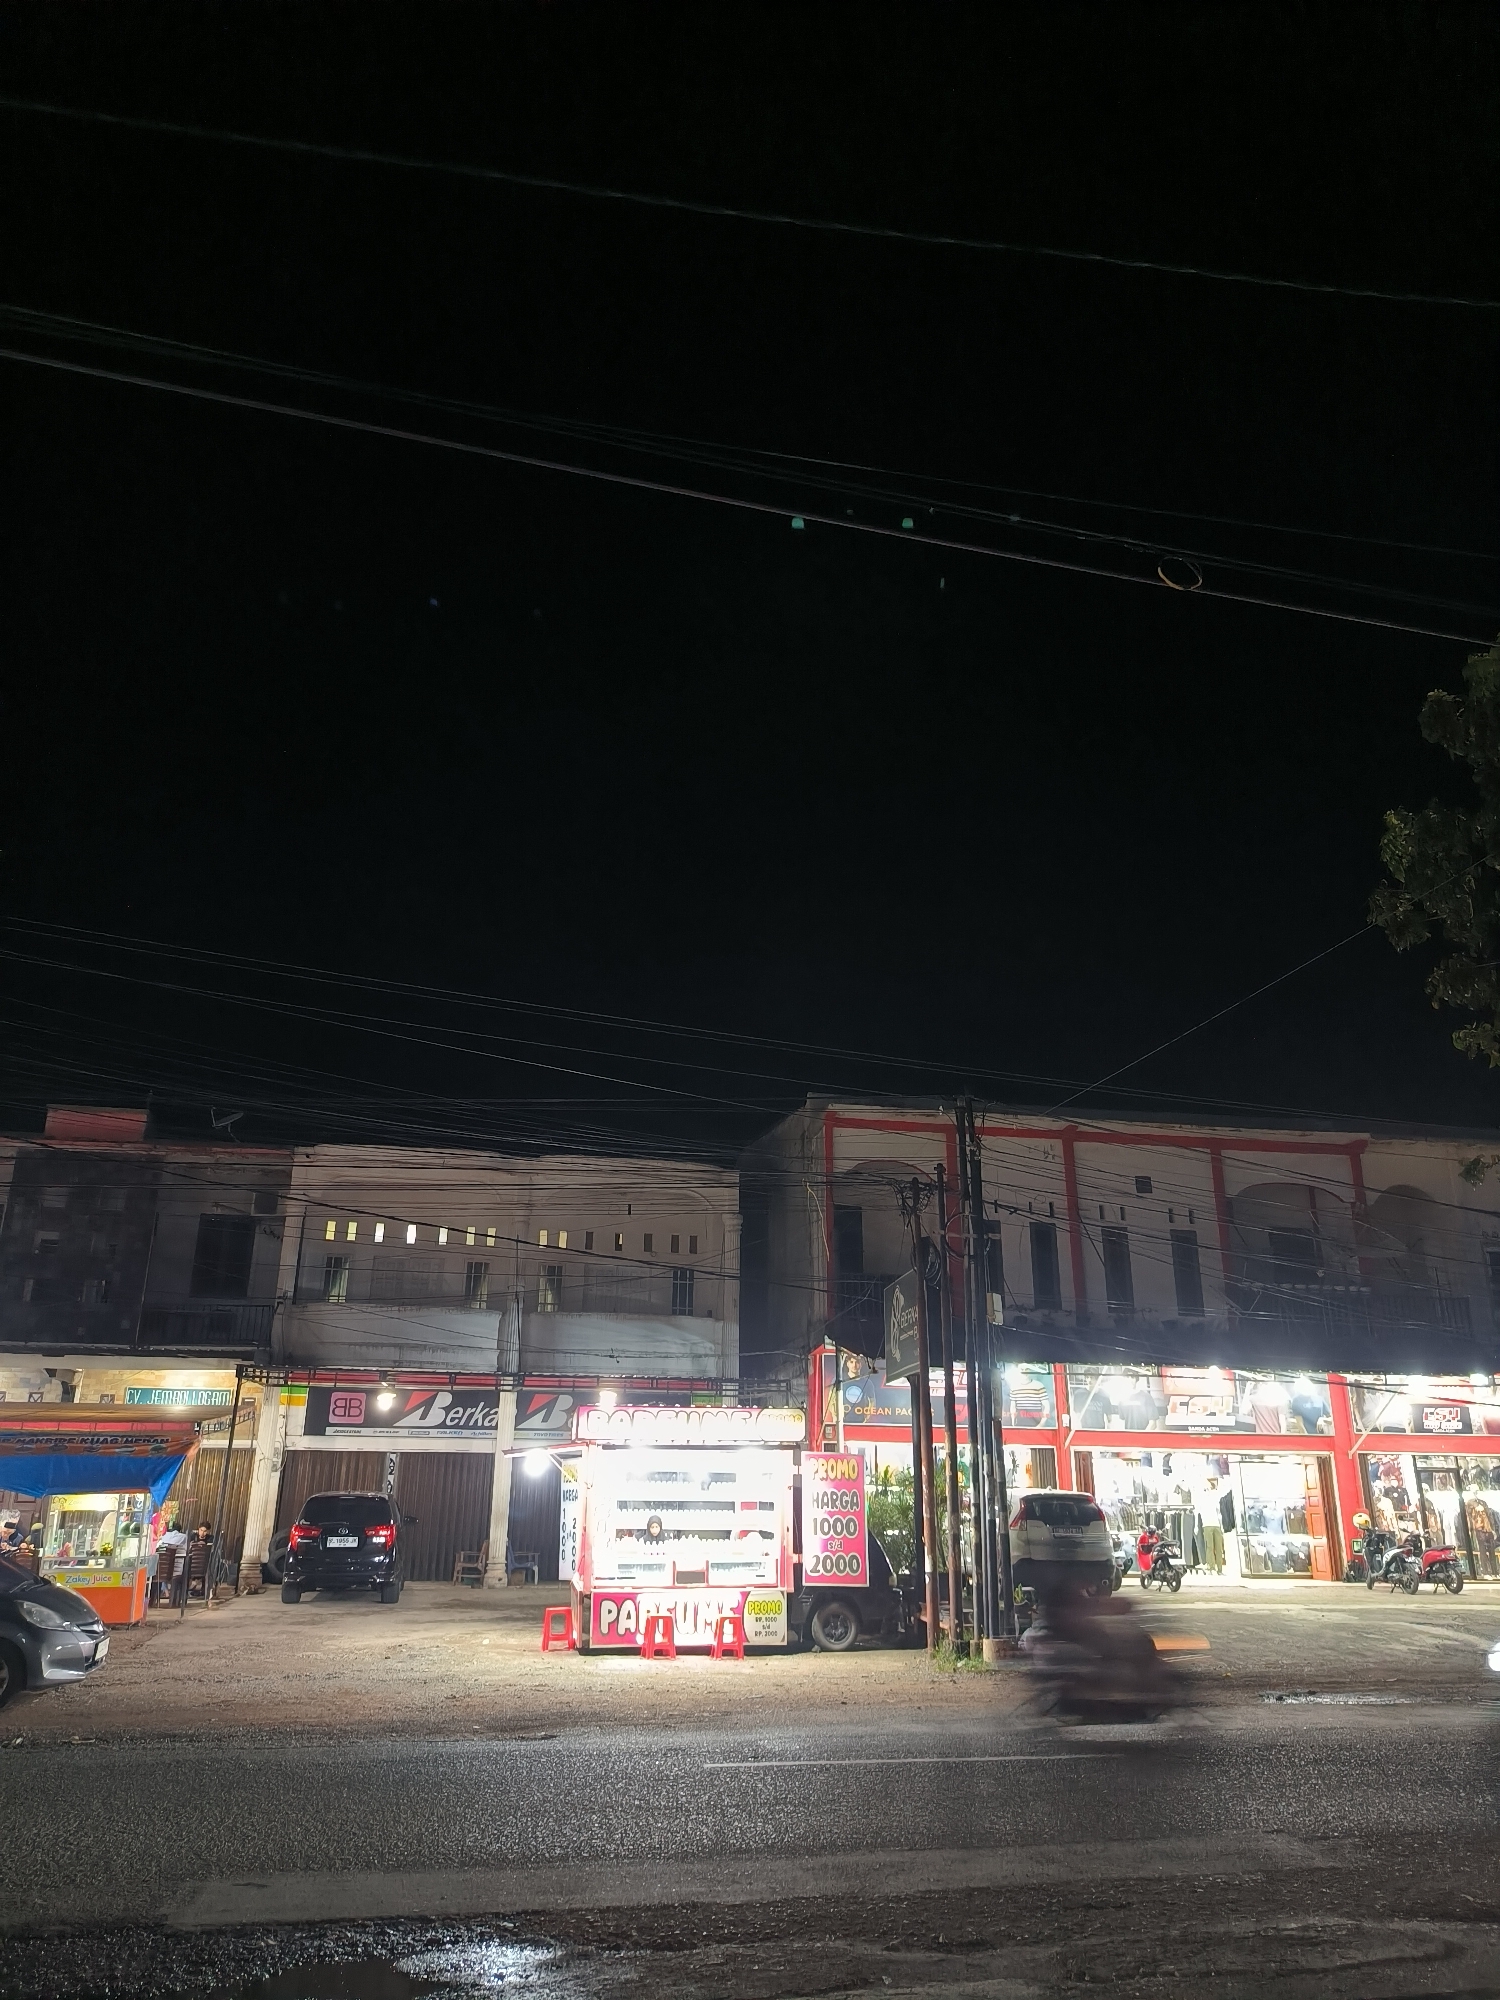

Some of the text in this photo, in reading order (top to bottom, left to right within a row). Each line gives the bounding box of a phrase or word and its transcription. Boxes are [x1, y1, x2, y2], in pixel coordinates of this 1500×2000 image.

[127, 1390, 142, 1405] CV.
[192, 1391, 230, 1406] LOGAM
[810, 1457, 858, 1481] PROMO
[813, 1490, 859, 1511] HARGA
[812, 1517, 858, 1537] 1000
[828, 1541, 843, 1551] s/d
[809, 1553, 861, 1574] 2000
[66, 1575, 112, 1585] Zakey Juice
[748, 1600, 782, 1615] PROMO
